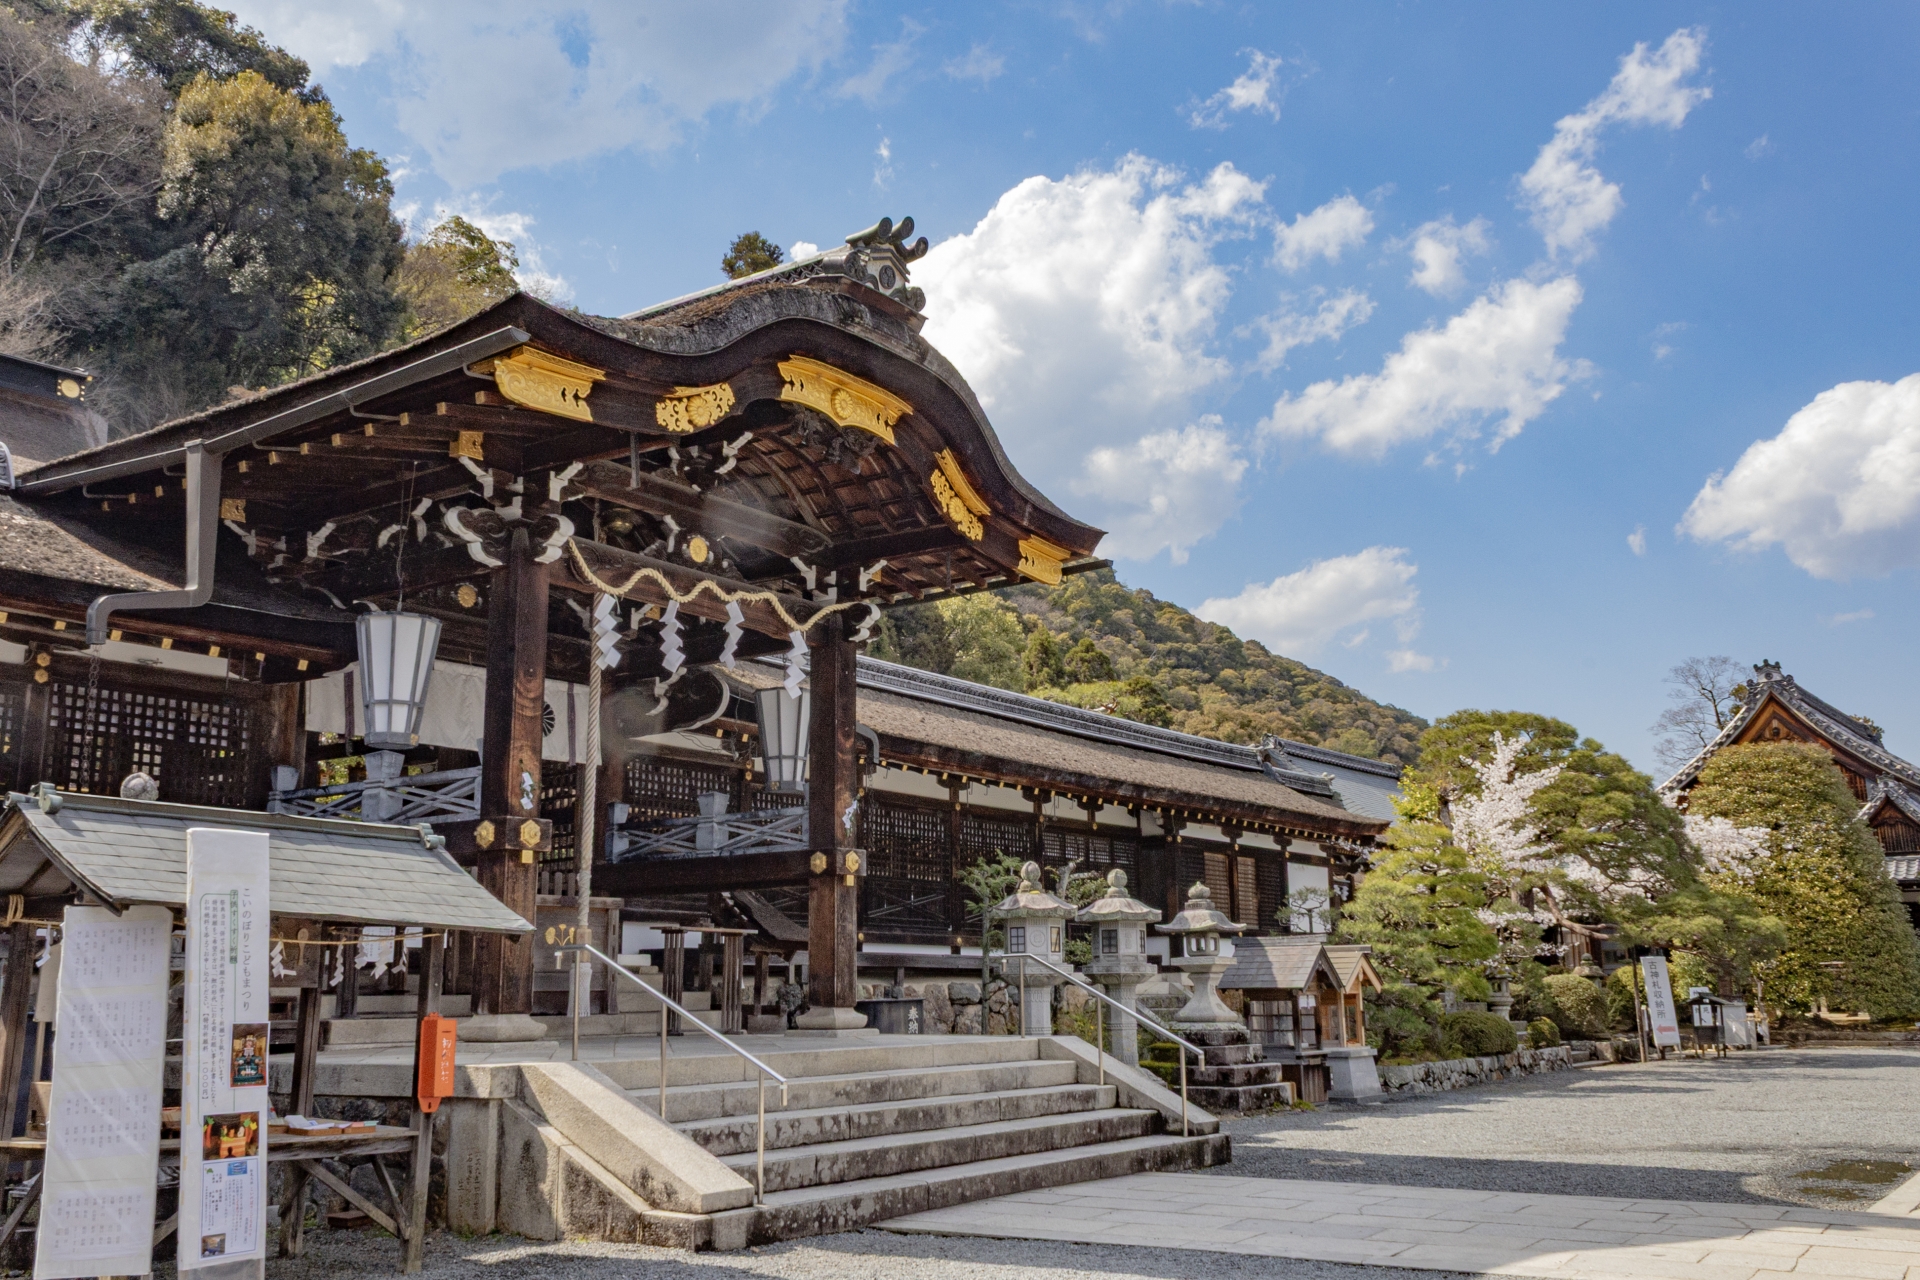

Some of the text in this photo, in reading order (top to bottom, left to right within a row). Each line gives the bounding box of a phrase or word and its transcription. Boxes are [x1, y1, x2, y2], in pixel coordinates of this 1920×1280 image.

[230, 891, 238, 962] 子供すくすく祈願
[242, 888, 252, 1011] こいのぼりこどもまつり
[908, 1006, 918, 1035] 奉納
[1648, 961, 1665, 1018] 古神札収納所
